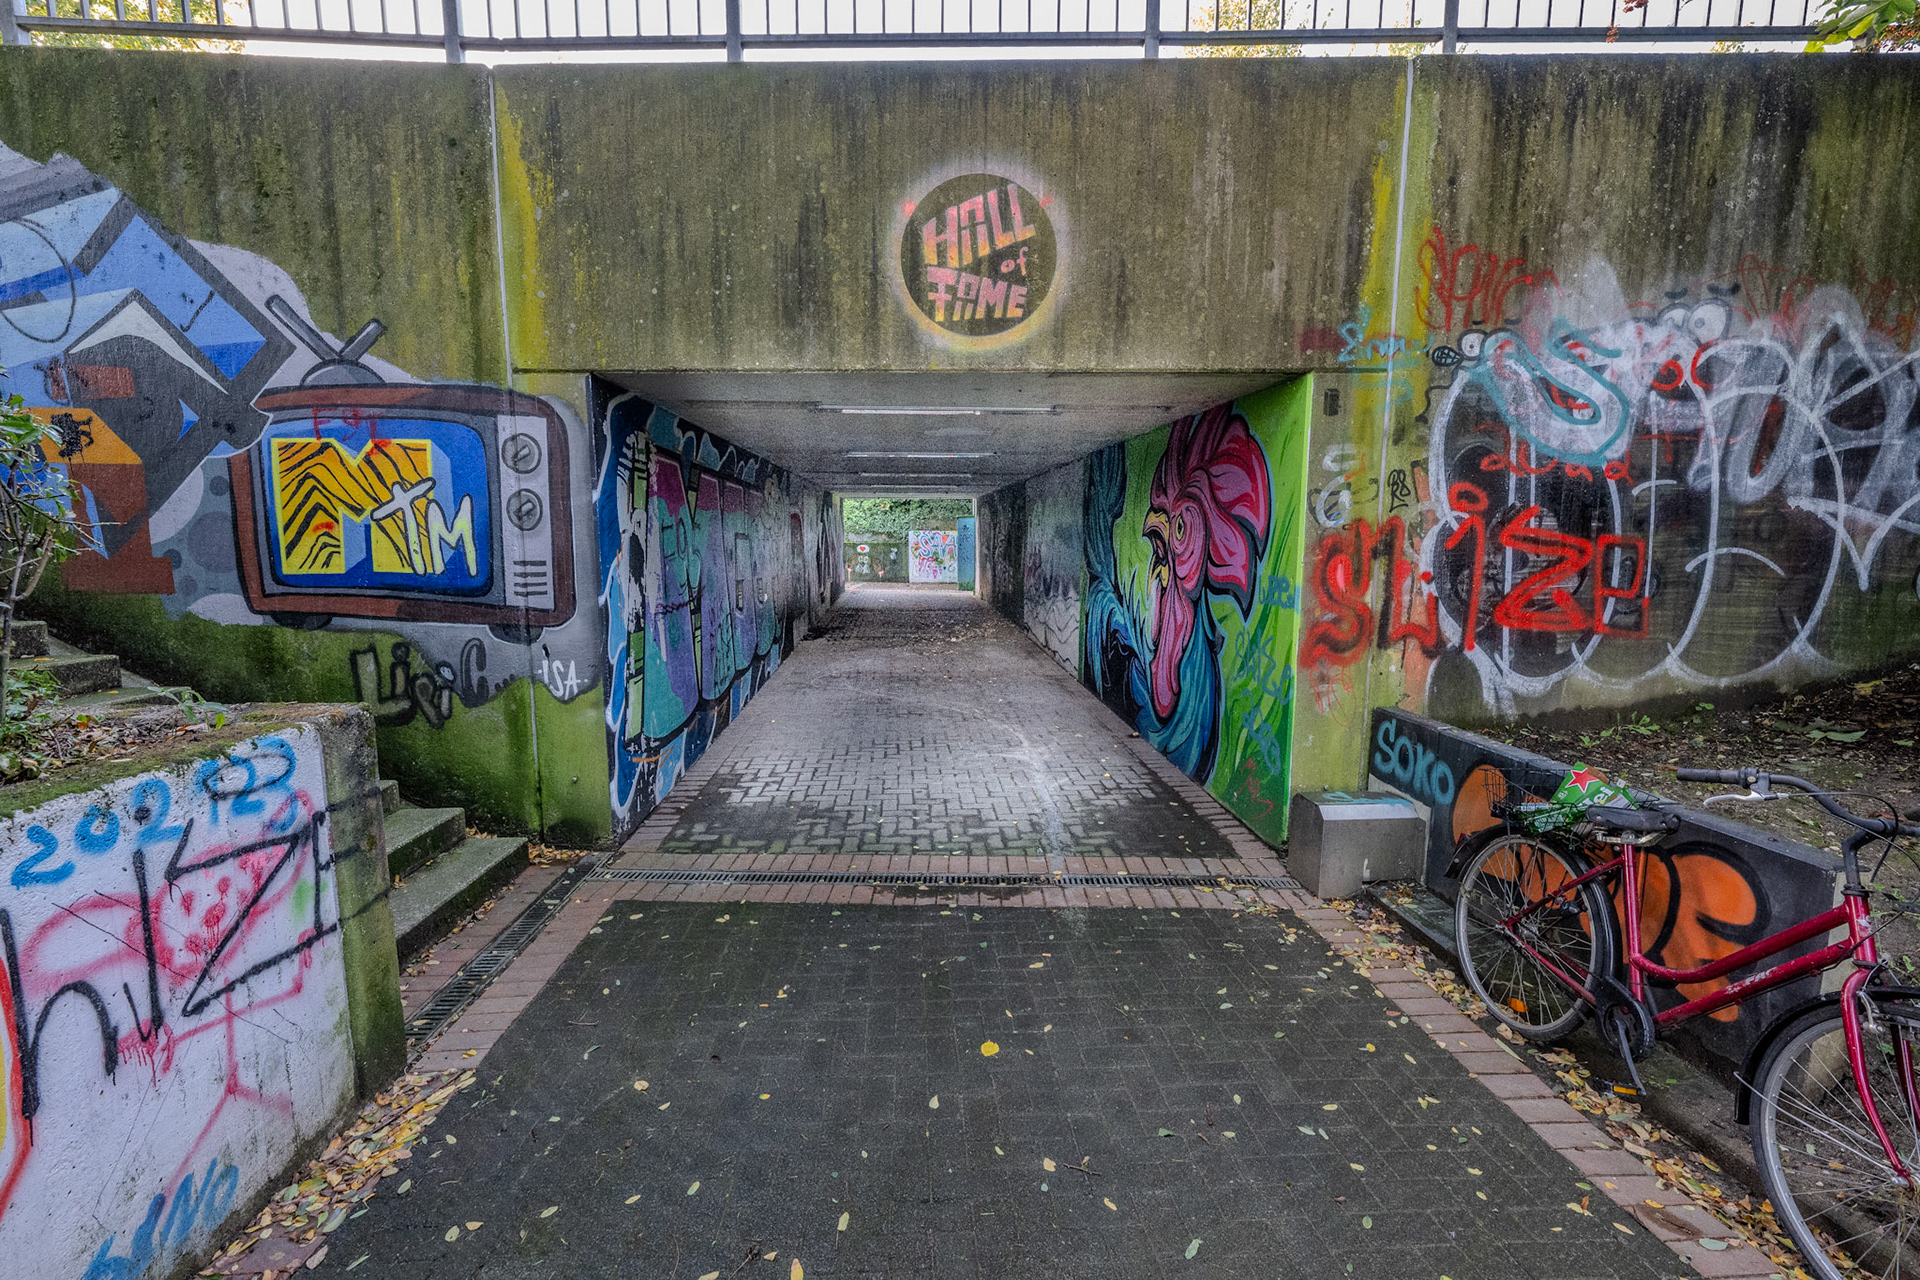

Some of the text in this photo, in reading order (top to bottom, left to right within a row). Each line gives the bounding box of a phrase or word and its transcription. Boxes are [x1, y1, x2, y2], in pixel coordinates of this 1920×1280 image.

[922, 183, 1036, 269] HALL
[1000, 246, 1029, 276] of
[926, 266, 1028, 322] FAME
[1374, 718, 1455, 805] SOKO
